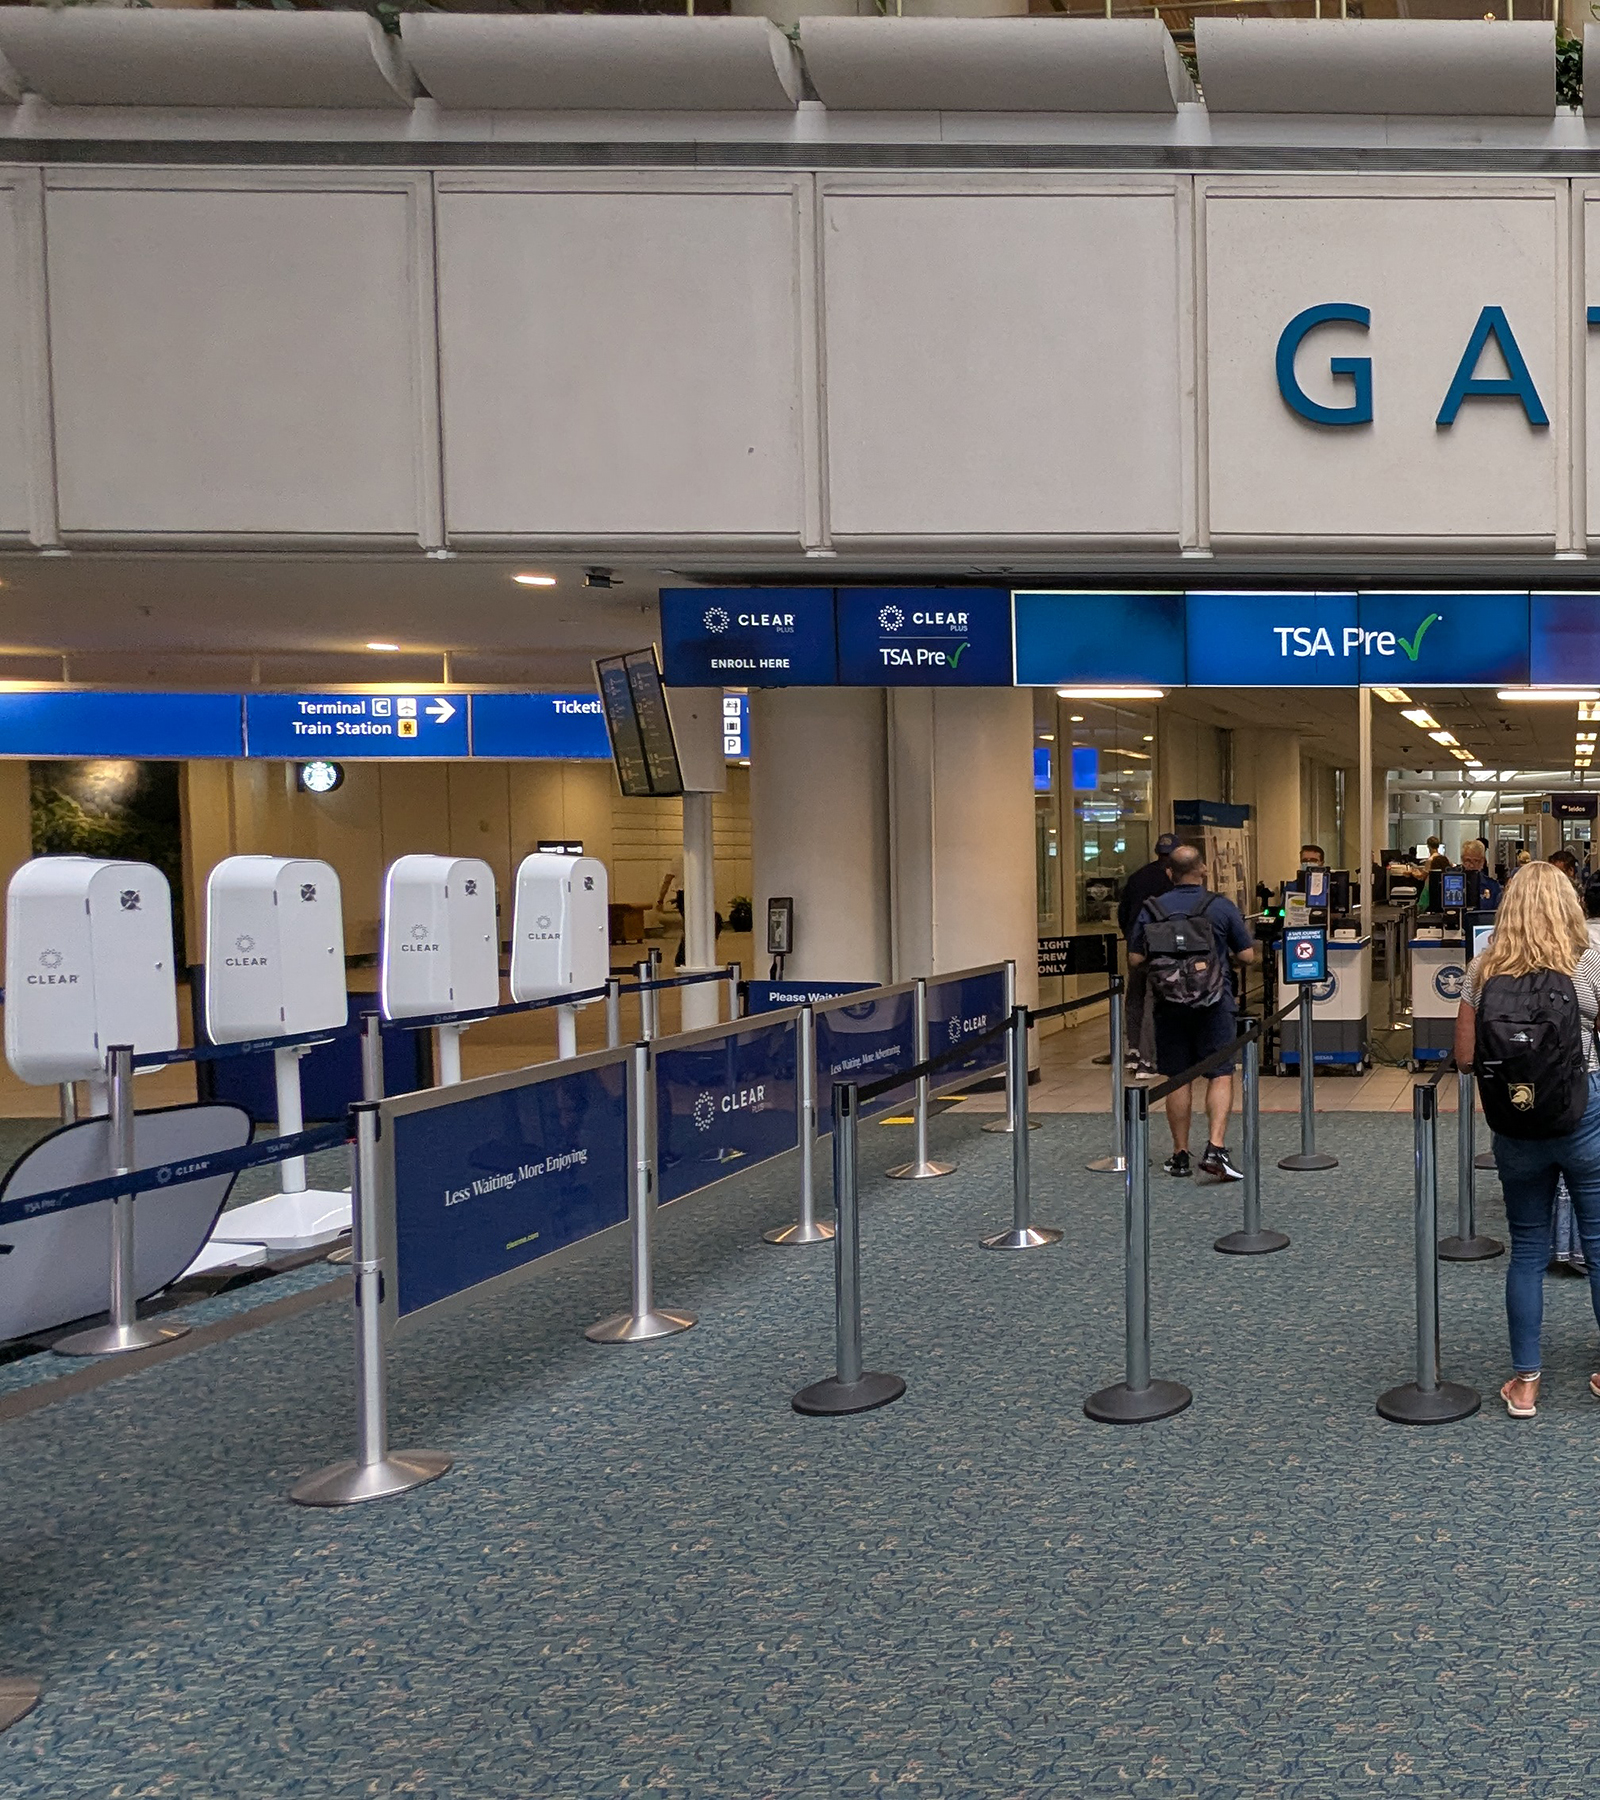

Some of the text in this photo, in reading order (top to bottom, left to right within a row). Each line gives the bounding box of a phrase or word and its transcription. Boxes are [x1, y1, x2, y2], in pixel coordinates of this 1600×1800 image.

[738, 614, 794, 626] CLEAR
[912, 613, 968, 624] CLEAR
[1273, 627, 1396, 656] TSA Pre
[879, 648, 945, 666] TSA Pre
[711, 658, 790, 669] ENROLL HERE
[298, 701, 387, 714] Terminal C
[553, 700, 603, 714] Ticketi
[292, 722, 392, 735] Train Station
[401, 944, 439, 952] CLEAR
[1038, 941, 1070, 950] LIGHT
[225, 957, 268, 966] CLEAR
[1037, 952, 1067, 962] CREW
[1038, 964, 1067, 974] ONLY
[27, 975, 79, 985] CLEAR
[769, 992, 805, 1002] Please
[963, 1015, 987, 1033] CLEAR
[830, 1064, 842, 1075] Less
[862, 1053, 874, 1064] More
[721, 1085, 765, 1113] CLEAR
[175, 1161, 208, 1177] CLEAR
[444, 1149, 588, 1207] Less Waiting, More Enjoying
